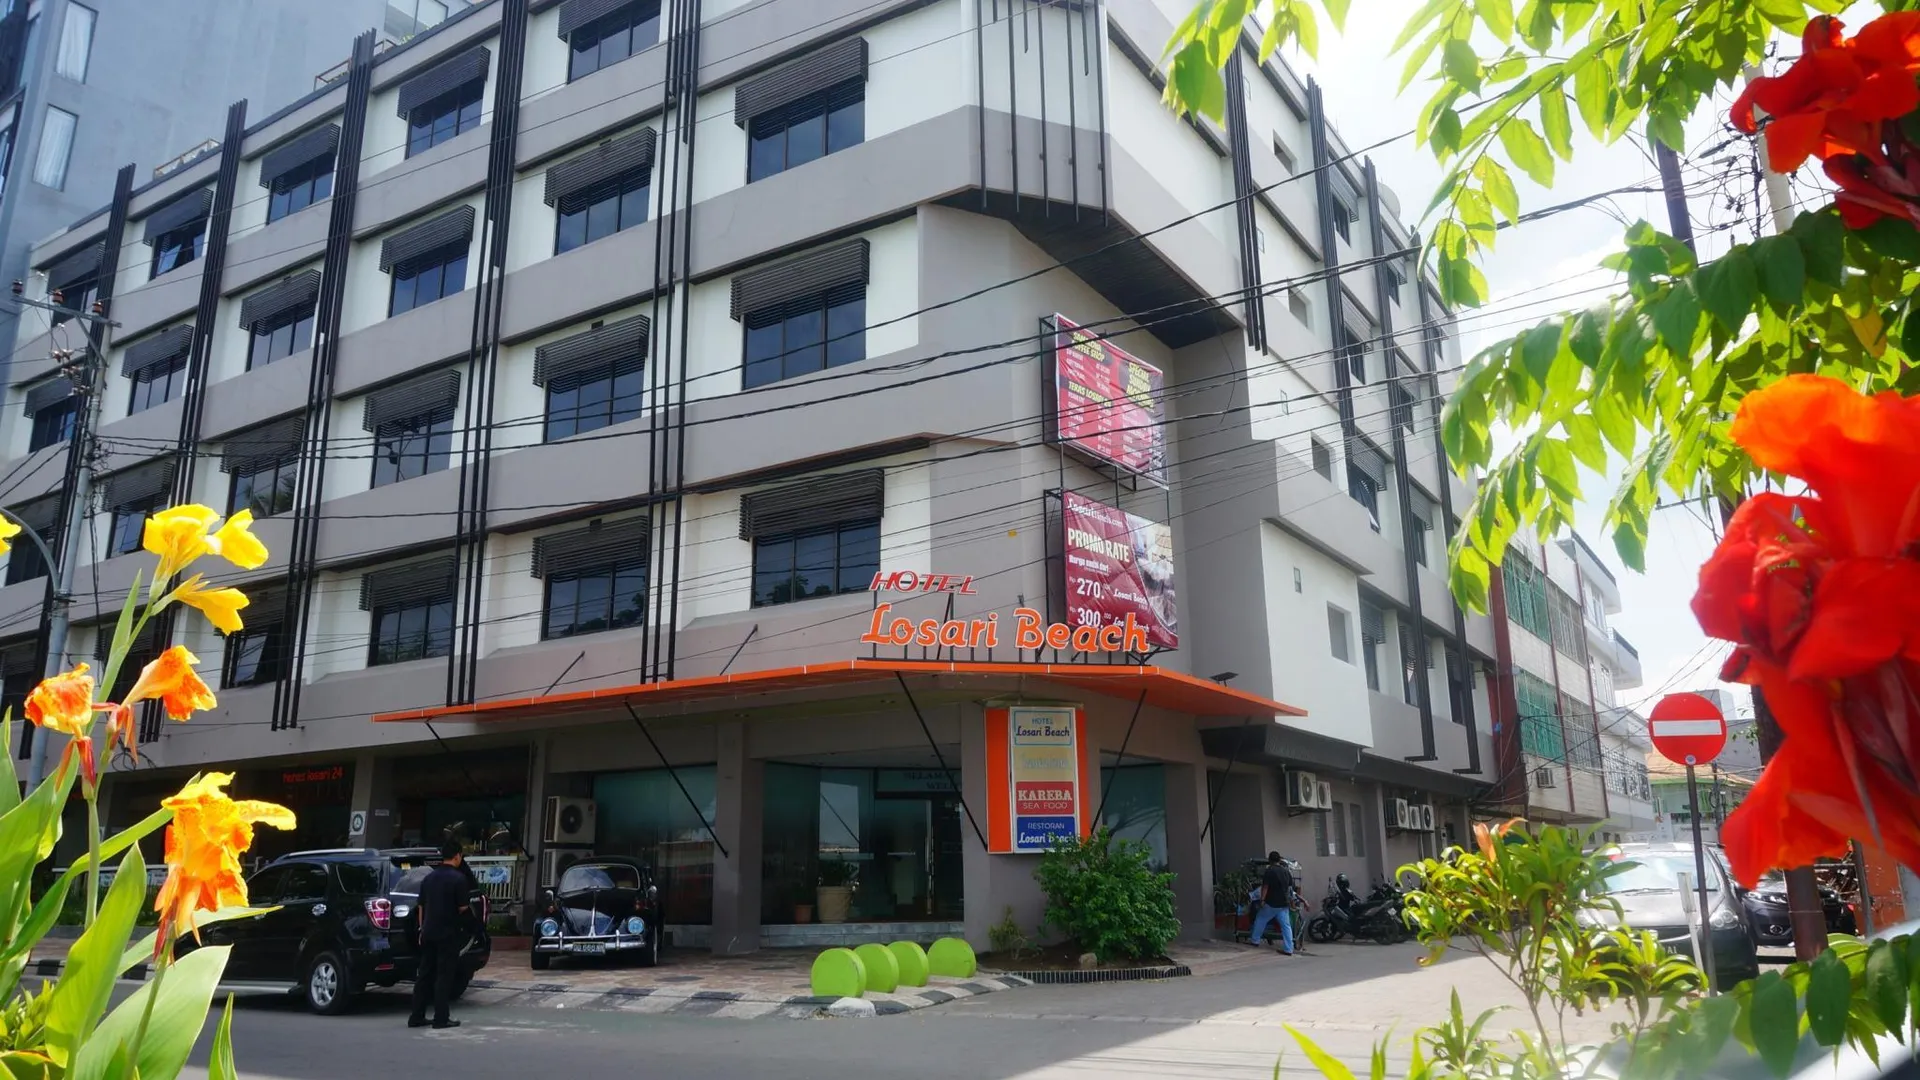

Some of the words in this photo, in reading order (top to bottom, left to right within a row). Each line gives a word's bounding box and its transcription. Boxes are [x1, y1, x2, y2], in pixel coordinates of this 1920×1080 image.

[1068, 527, 1105, 554] PROMO
[1106, 541, 1130, 563] RATE
[869, 570, 978, 595] HOTEL
[860, 602, 999, 648] Losari
[1014, 607, 1151, 654] Beach
[1032, 717, 1053, 725] HOTEL
[1016, 725, 1042, 737] Losari
[1045, 725, 1070, 737] Beach
[1018, 790, 1072, 801] KAREBA
[1028, 822, 1065, 830] RESTORAN
[1018, 832, 1046, 844] Losari
